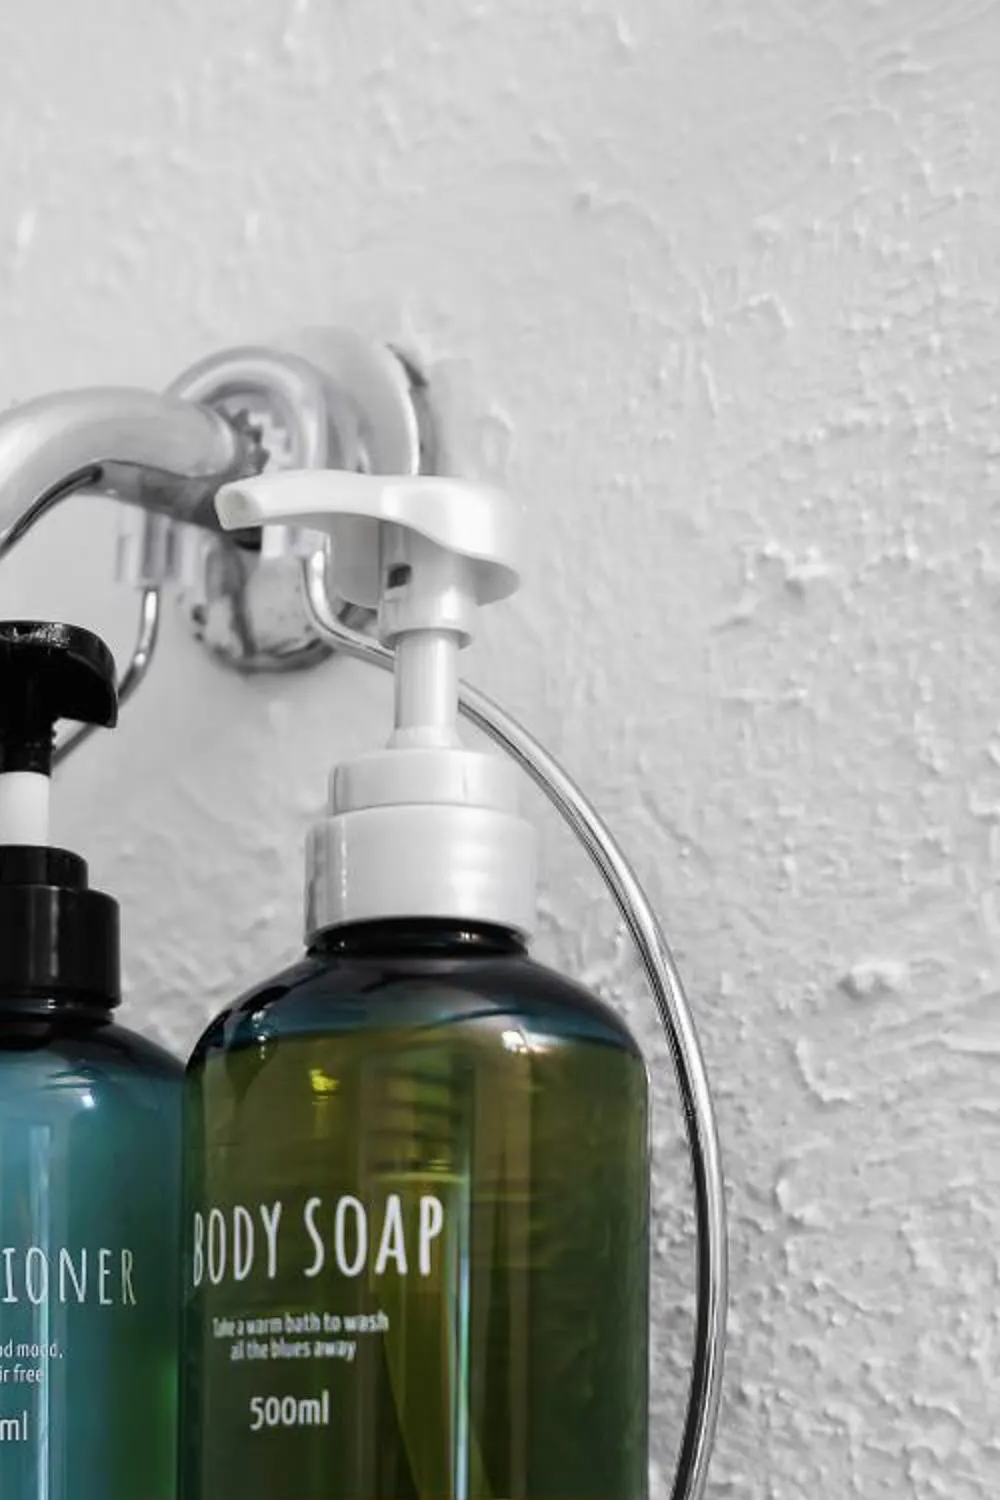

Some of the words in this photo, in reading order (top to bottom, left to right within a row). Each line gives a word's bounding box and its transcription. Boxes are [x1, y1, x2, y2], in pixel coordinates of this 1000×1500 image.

[193, 1200, 282, 1287] BODY
[304, 1194, 444, 1277] SOAP
[245, 1317, 283, 1335] warm
[284, 1312, 320, 1333] bath
[323, 1312, 341, 1332] to
[344, 1309, 389, 1332] wash
[247, 1340, 268, 1359] the
[270, 1337, 311, 1360] blues
[313, 1340, 357, 1362] away
[13, 1364, 44, 1383] free
[250, 1389, 330, 1431] 500ml
